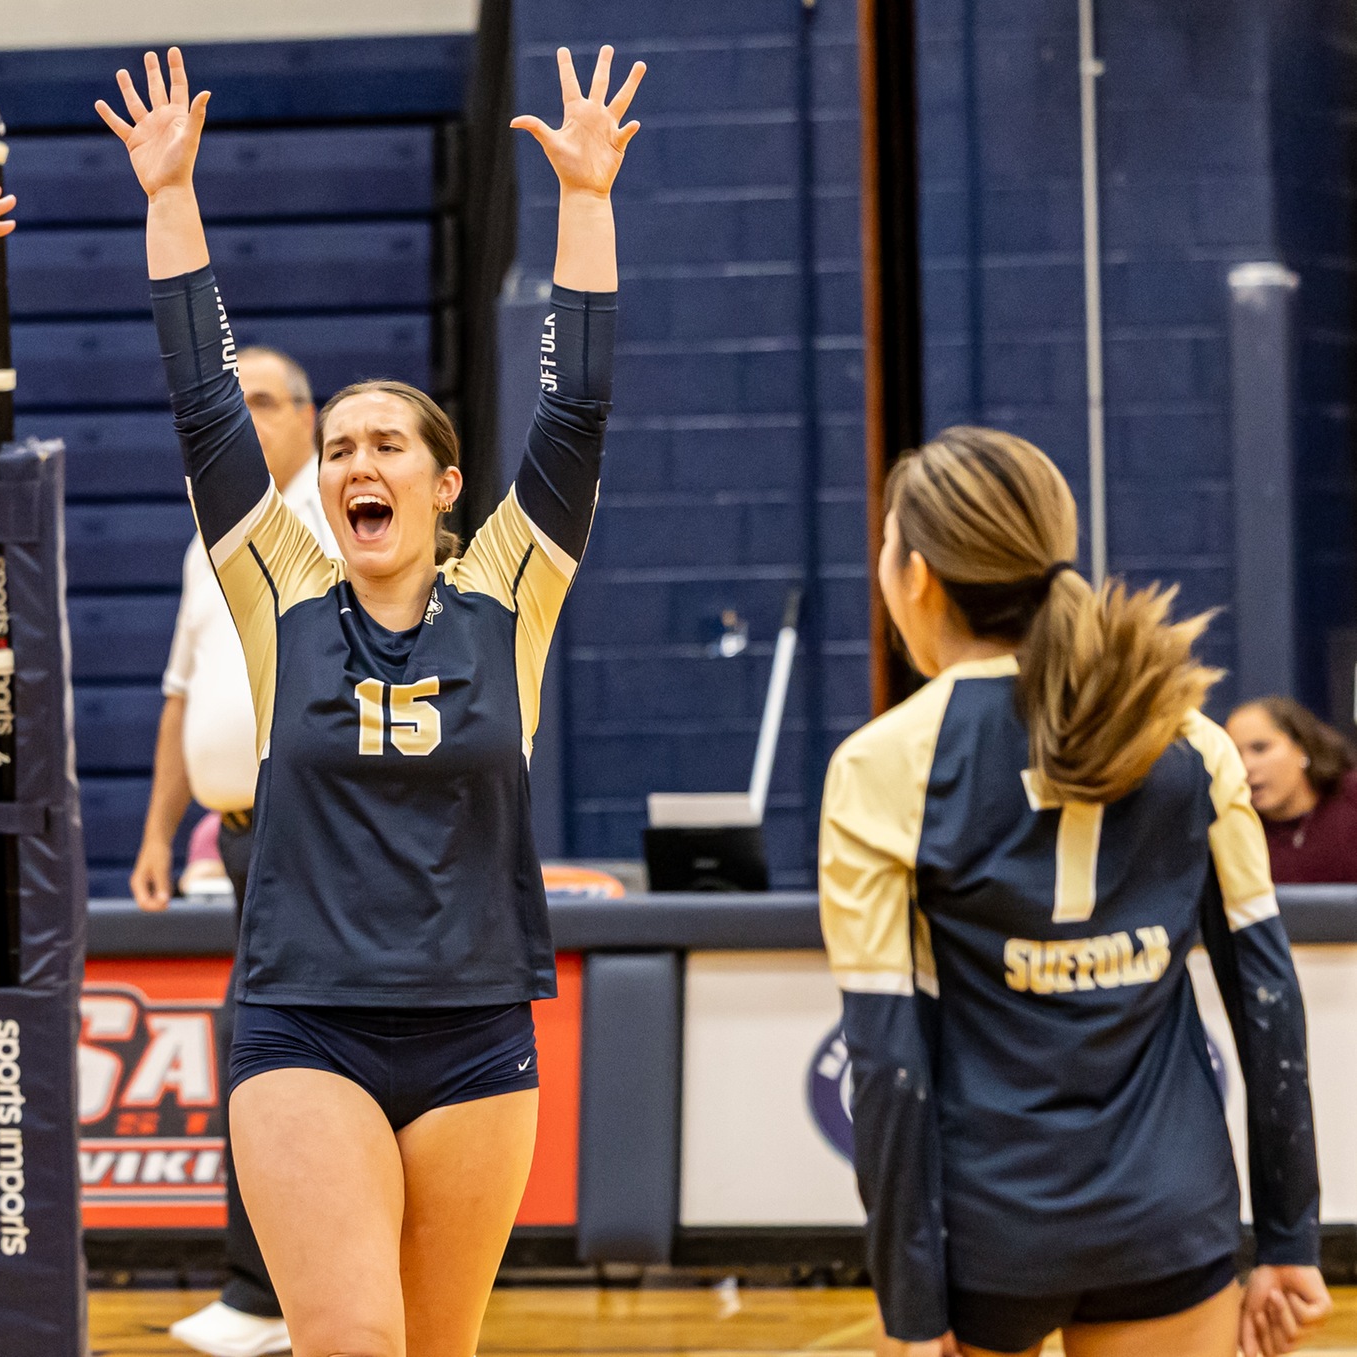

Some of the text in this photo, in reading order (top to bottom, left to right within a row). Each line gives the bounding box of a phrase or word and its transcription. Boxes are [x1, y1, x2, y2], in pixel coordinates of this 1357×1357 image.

[354, 676, 442, 756] 15
[1004, 925, 1171, 995] SUFFOLK
[79, 1151, 227, 1184] VIKI
